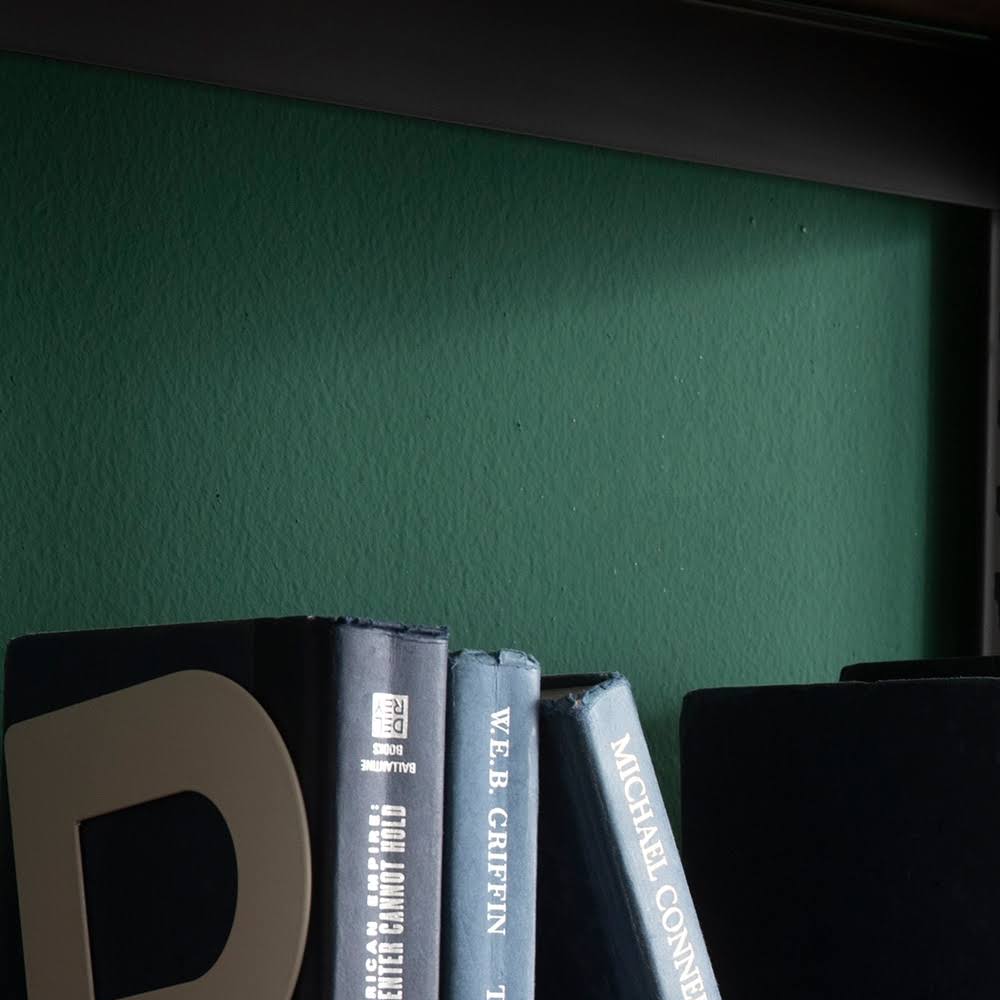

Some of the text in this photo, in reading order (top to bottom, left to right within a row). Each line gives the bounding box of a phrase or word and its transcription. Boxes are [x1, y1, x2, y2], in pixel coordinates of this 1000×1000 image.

[376, 699, 404, 715] REY
[376, 717, 403, 734] DEL
[360, 759, 417, 774] BALLANTINE
[373, 742, 404, 756] BOOKS
[380, 804, 407, 853] HOLD
[486, 706, 511, 936] W.E.B. GRIFFIN
[610, 732, 669, 882] MICHAEL
[367, 804, 381, 907] EMPIRE:
[378, 859, 405, 935] CANNOT
